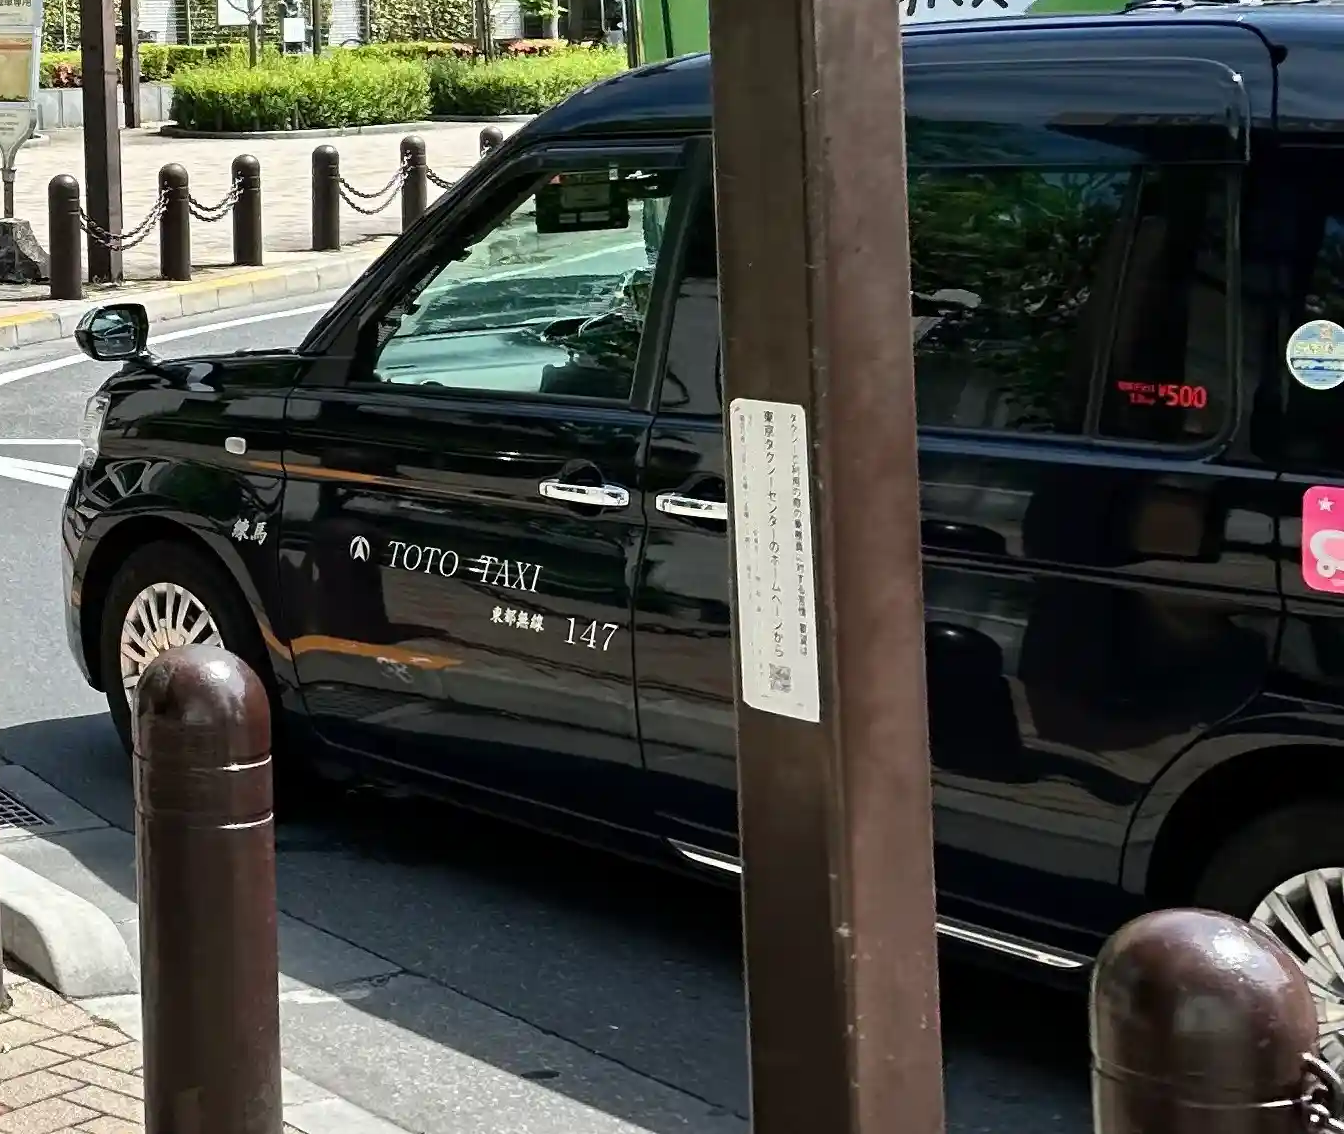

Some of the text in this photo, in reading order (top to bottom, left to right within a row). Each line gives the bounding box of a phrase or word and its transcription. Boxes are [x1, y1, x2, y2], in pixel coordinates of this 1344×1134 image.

[387, 540, 545, 594] TOTO TAXI
[564, 617, 619, 651] 147
